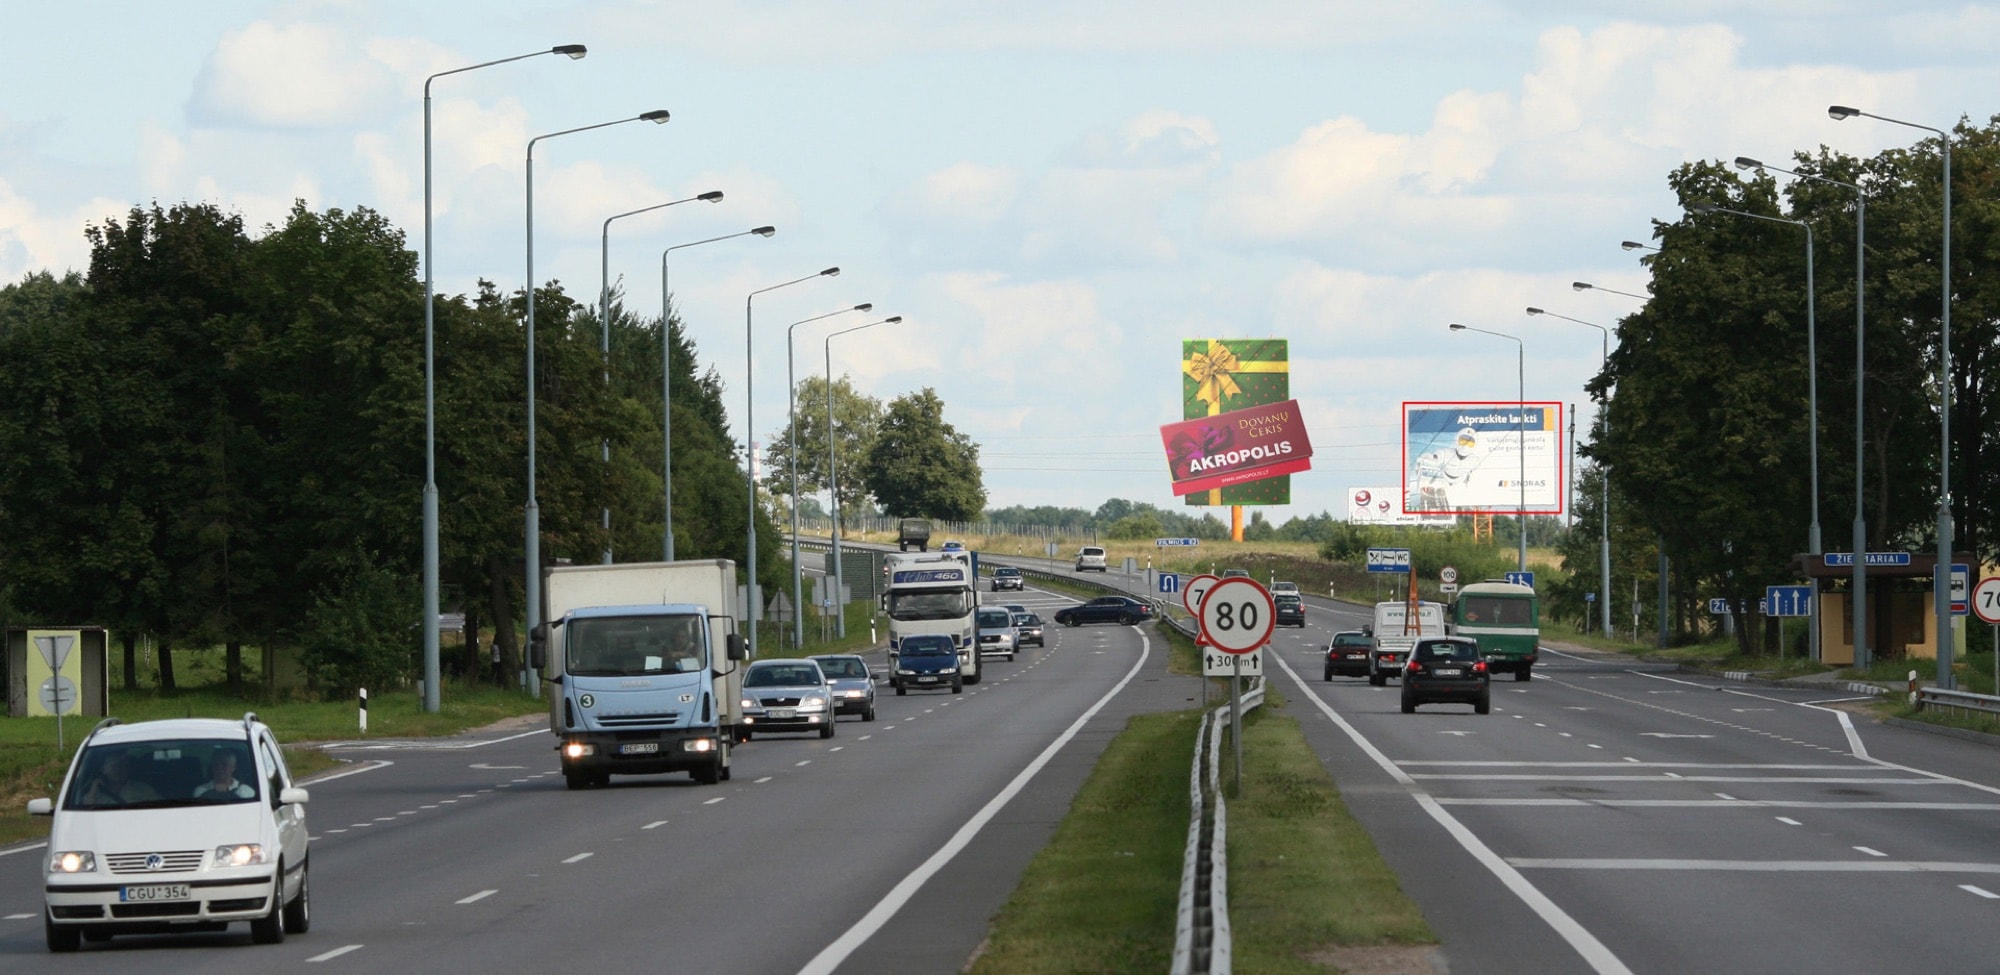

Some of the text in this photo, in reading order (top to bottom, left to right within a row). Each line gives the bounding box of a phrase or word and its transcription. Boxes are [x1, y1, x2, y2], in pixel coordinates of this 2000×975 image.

[1239, 411, 1289, 429] DOVANŲ
[1457, 414, 1507, 426] Atpraskite
[1249, 423, 1283, 438] ČEKIS
[1190, 441, 1292, 473] AKROPOLIS
[1510, 479, 1546, 488] SNORAS
[1397, 553, 1408, 562] WC
[1837, 553, 1899, 564] ŽIEARIAI
[934, 572, 959, 580] 460
[1443, 571, 1455, 579] 100
[1194, 589, 1204, 606] 7
[1216, 601, 1258, 631] 80
[1240, 658, 1250, 667] m
[582, 695, 592, 707] 3
[127, 885, 188, 900] CGU 354
